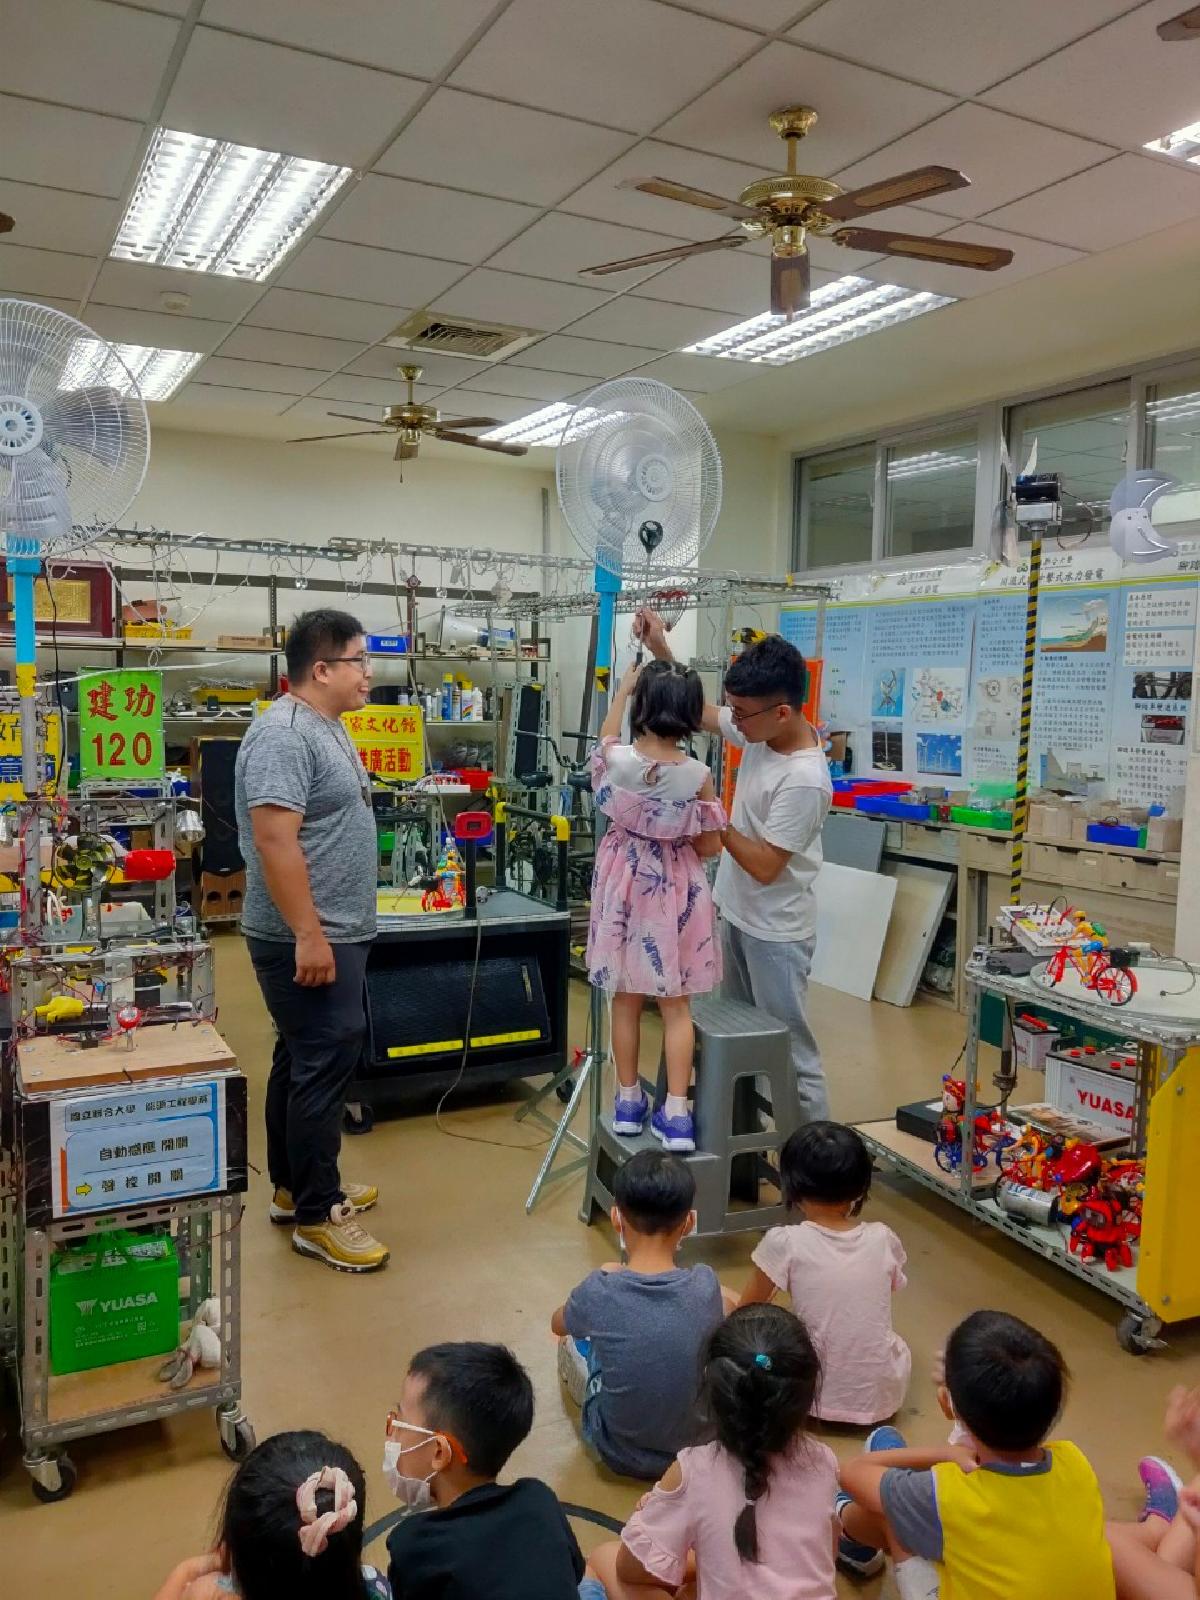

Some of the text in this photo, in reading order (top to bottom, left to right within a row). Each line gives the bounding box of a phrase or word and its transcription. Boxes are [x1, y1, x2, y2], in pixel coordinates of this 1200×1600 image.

[87, 680, 156, 721] 建功
[341, 715, 416, 734] 家文化館
[92, 731, 153, 767] 120
[1077, 1089, 1136, 1120] YUASA
[100, 1291, 159, 1313] YUASA
